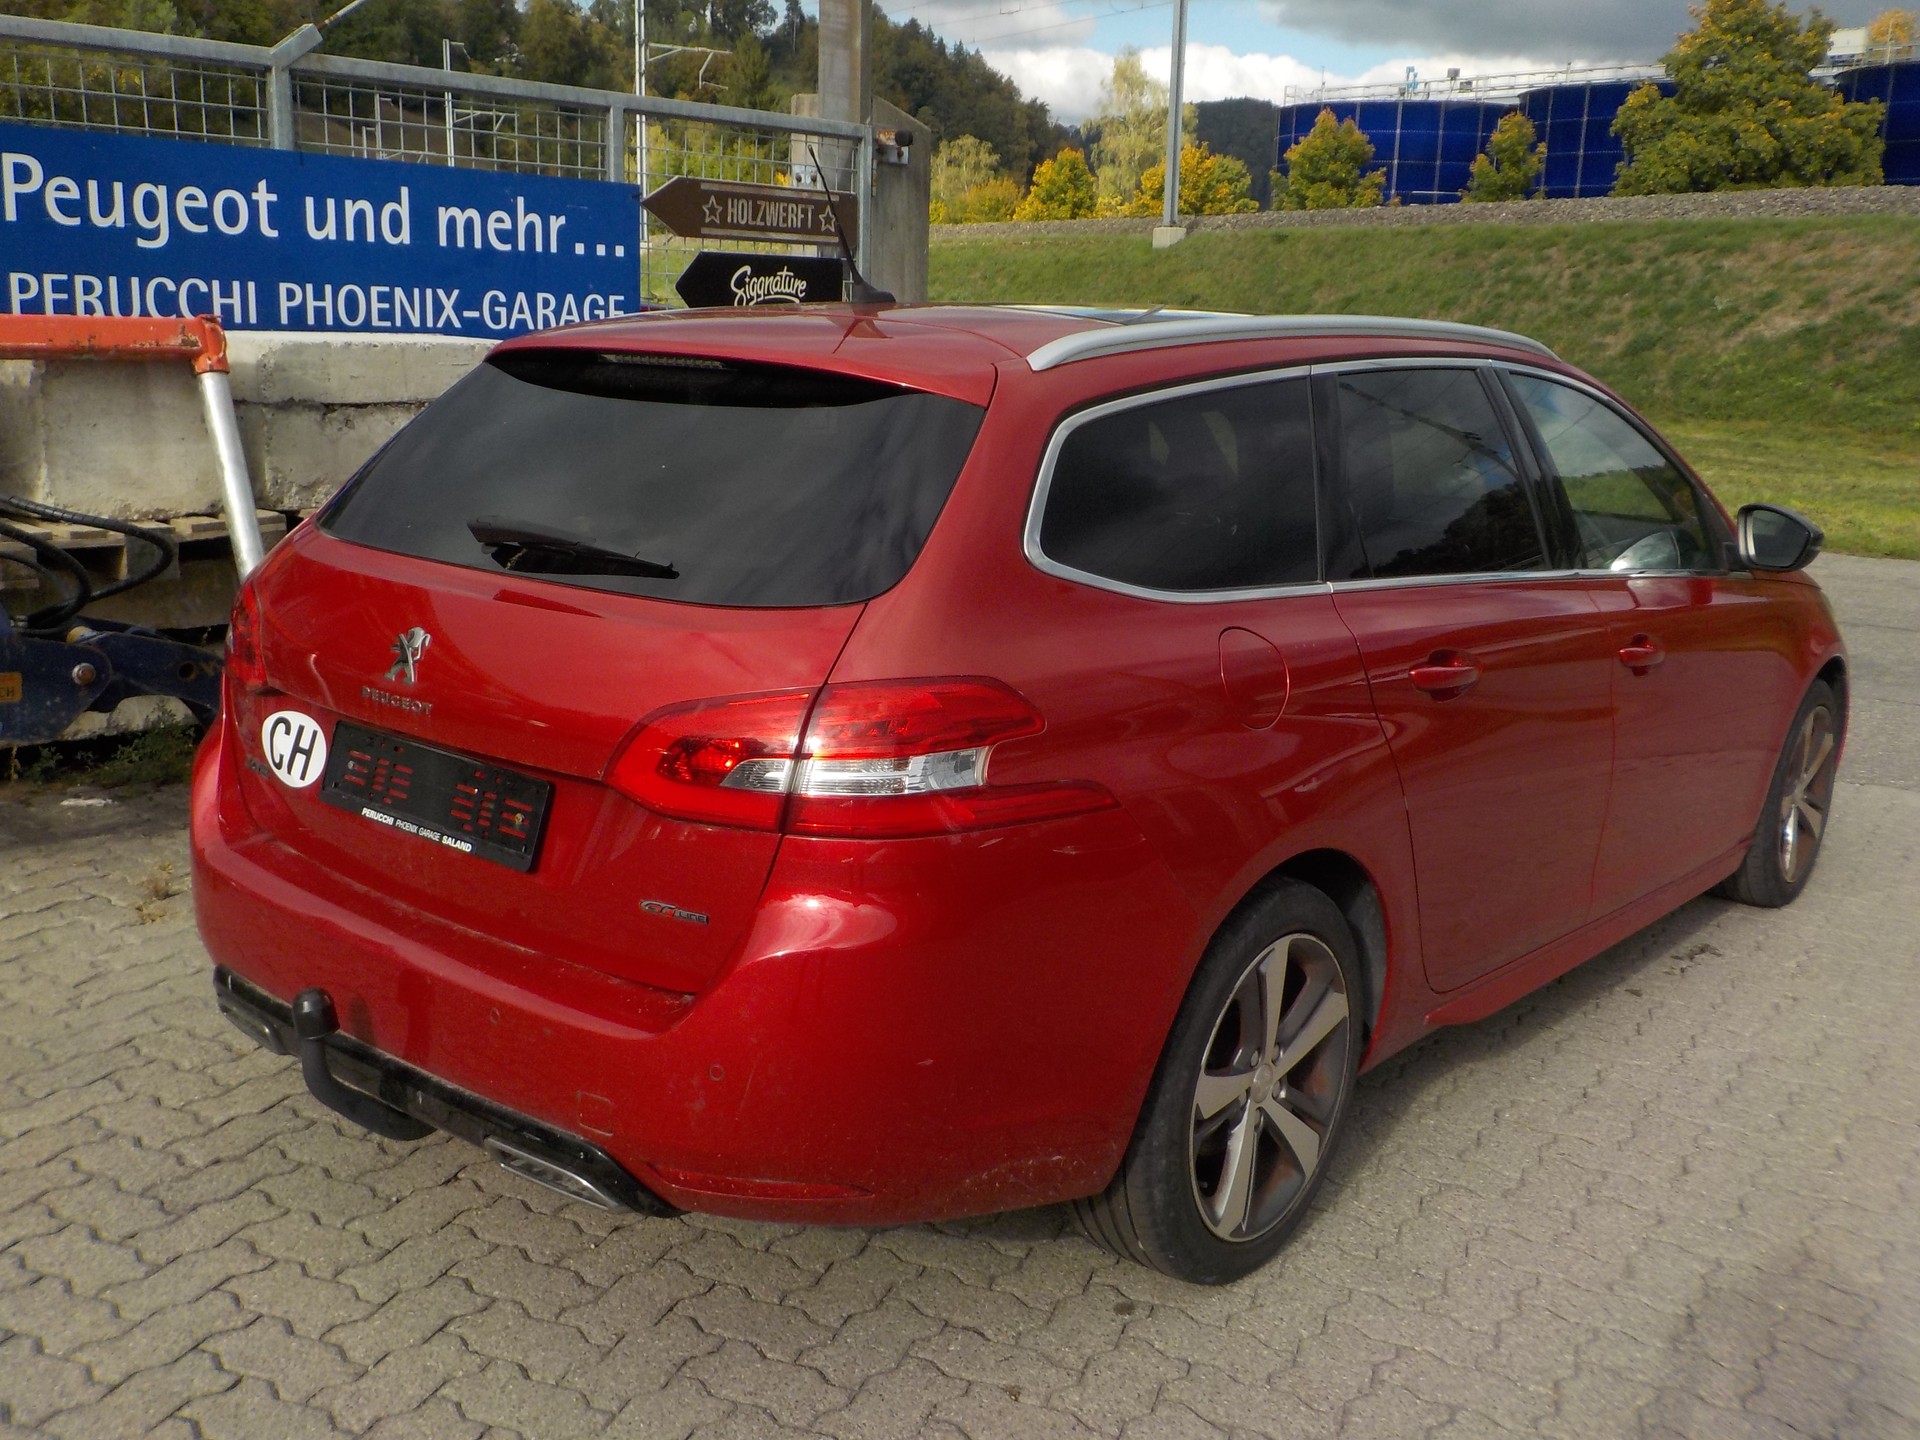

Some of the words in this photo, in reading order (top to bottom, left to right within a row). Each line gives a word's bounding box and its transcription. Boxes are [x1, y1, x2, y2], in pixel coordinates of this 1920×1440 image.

[2, 152, 279, 248] Peugeot
[305, 187, 411, 244] und
[727, 197, 815, 229] HOLZWERFT
[9, 272, 257, 324] PERUCCHI
[279, 282, 625, 330] PHOENIX-GARAGE
[361, 685, 433, 715] PEUGEOT
[269, 716, 319, 781] CH
[361, 807, 395, 826] PERUCCHI
[395, 819, 419, 834] PHOENIX
[418, 827, 441, 842] GARAGE
[442, 835, 472, 852] SALAND
